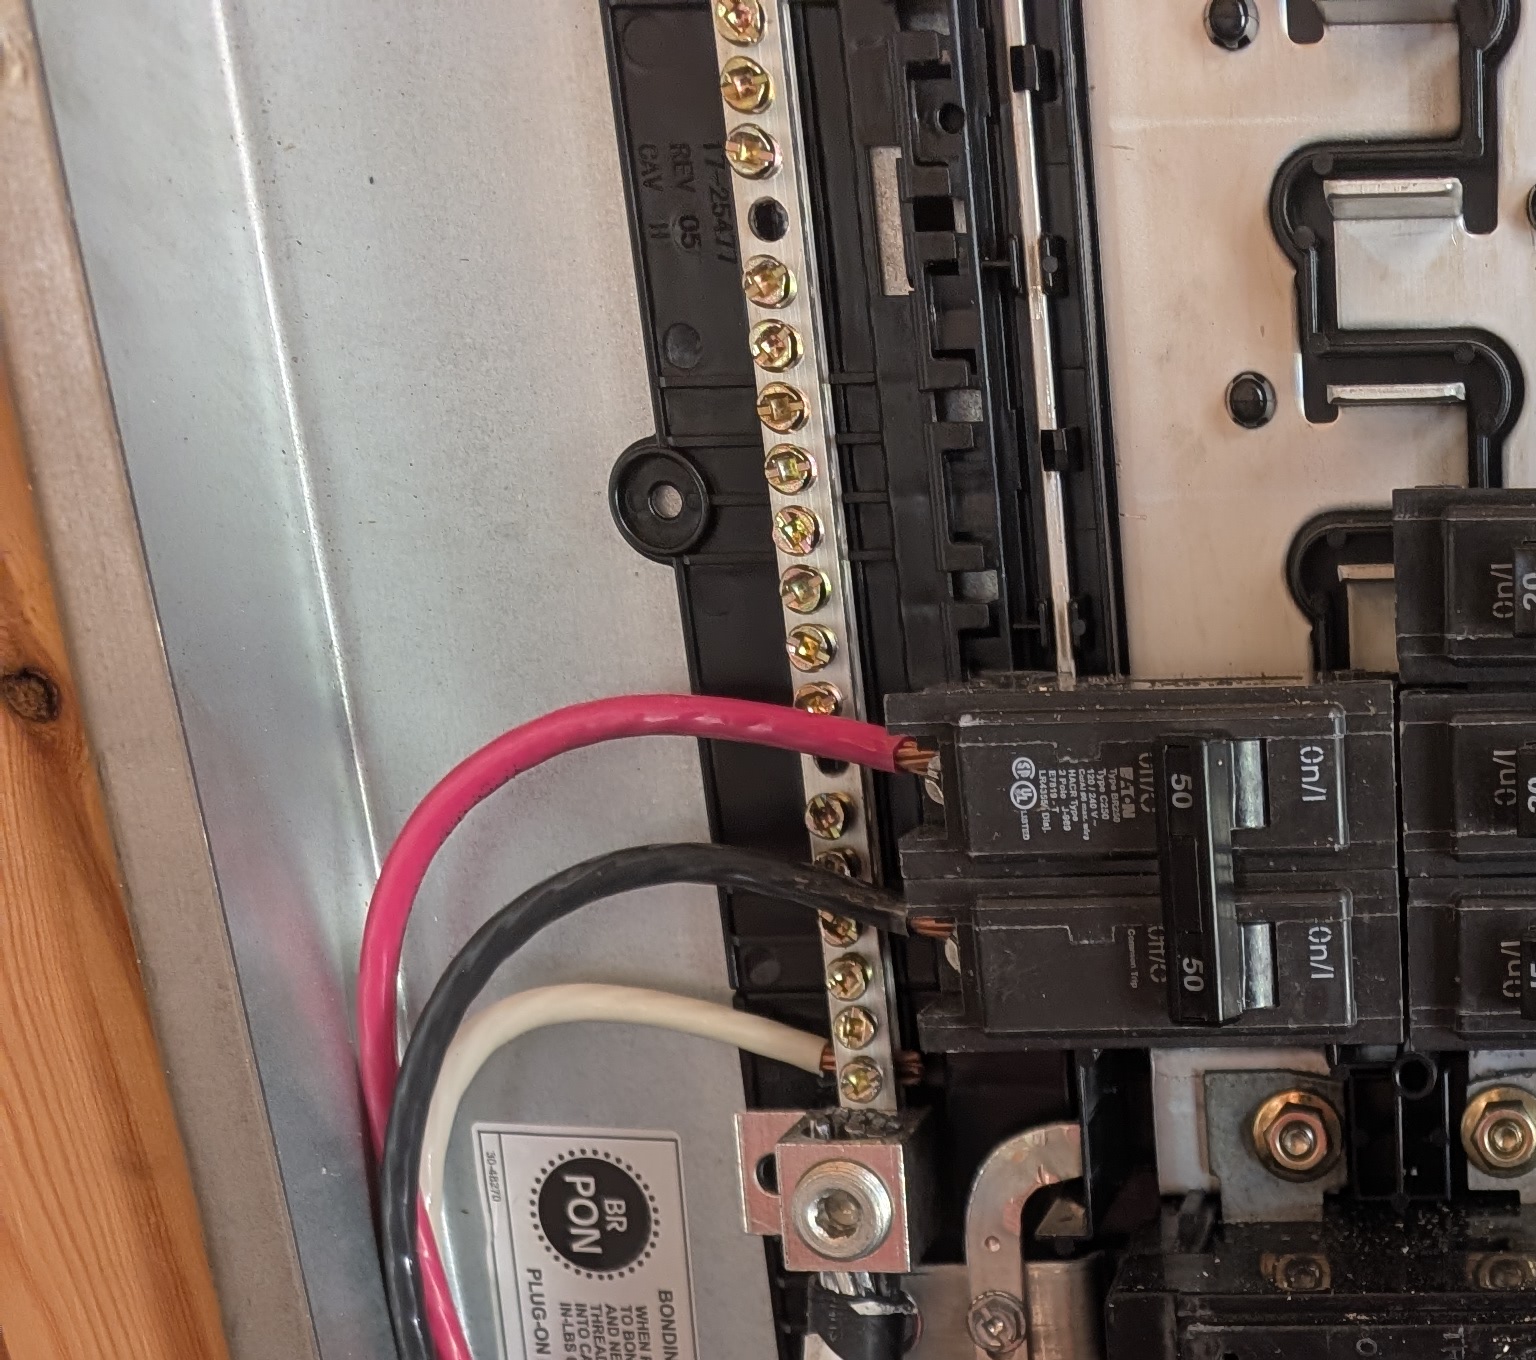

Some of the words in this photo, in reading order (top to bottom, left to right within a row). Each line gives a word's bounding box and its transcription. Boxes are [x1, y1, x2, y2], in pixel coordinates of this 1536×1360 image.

[669, 143, 696, 193] REV
[679, 214, 702, 249] 05
[1068, 770, 1076, 797] HACR
[1097, 769, 1106, 792] Type
[1108, 769, 1117, 790] Type
[1120, 767, 1135, 818] EATON
[1171, 773, 1192, 809] 50
[1069, 799, 1078, 821] Type
[1100, 795, 1109, 820] C250
[1128, 971, 1139, 989] Trip
[1182, 957, 1204, 992] 50
[561, 1174, 603, 1255] PON
[603, 1198, 628, 1232] BR
[526, 1268, 550, 1358] PLUG-ON
[559, 1303, 576, 1352] IN-LBS
[574, 1304, 588, 1341] INTO
[605, 1305, 619, 1337] AND
[620, 1305, 633, 1326] TO
[635, 1306, 650, 1352] WHEN
